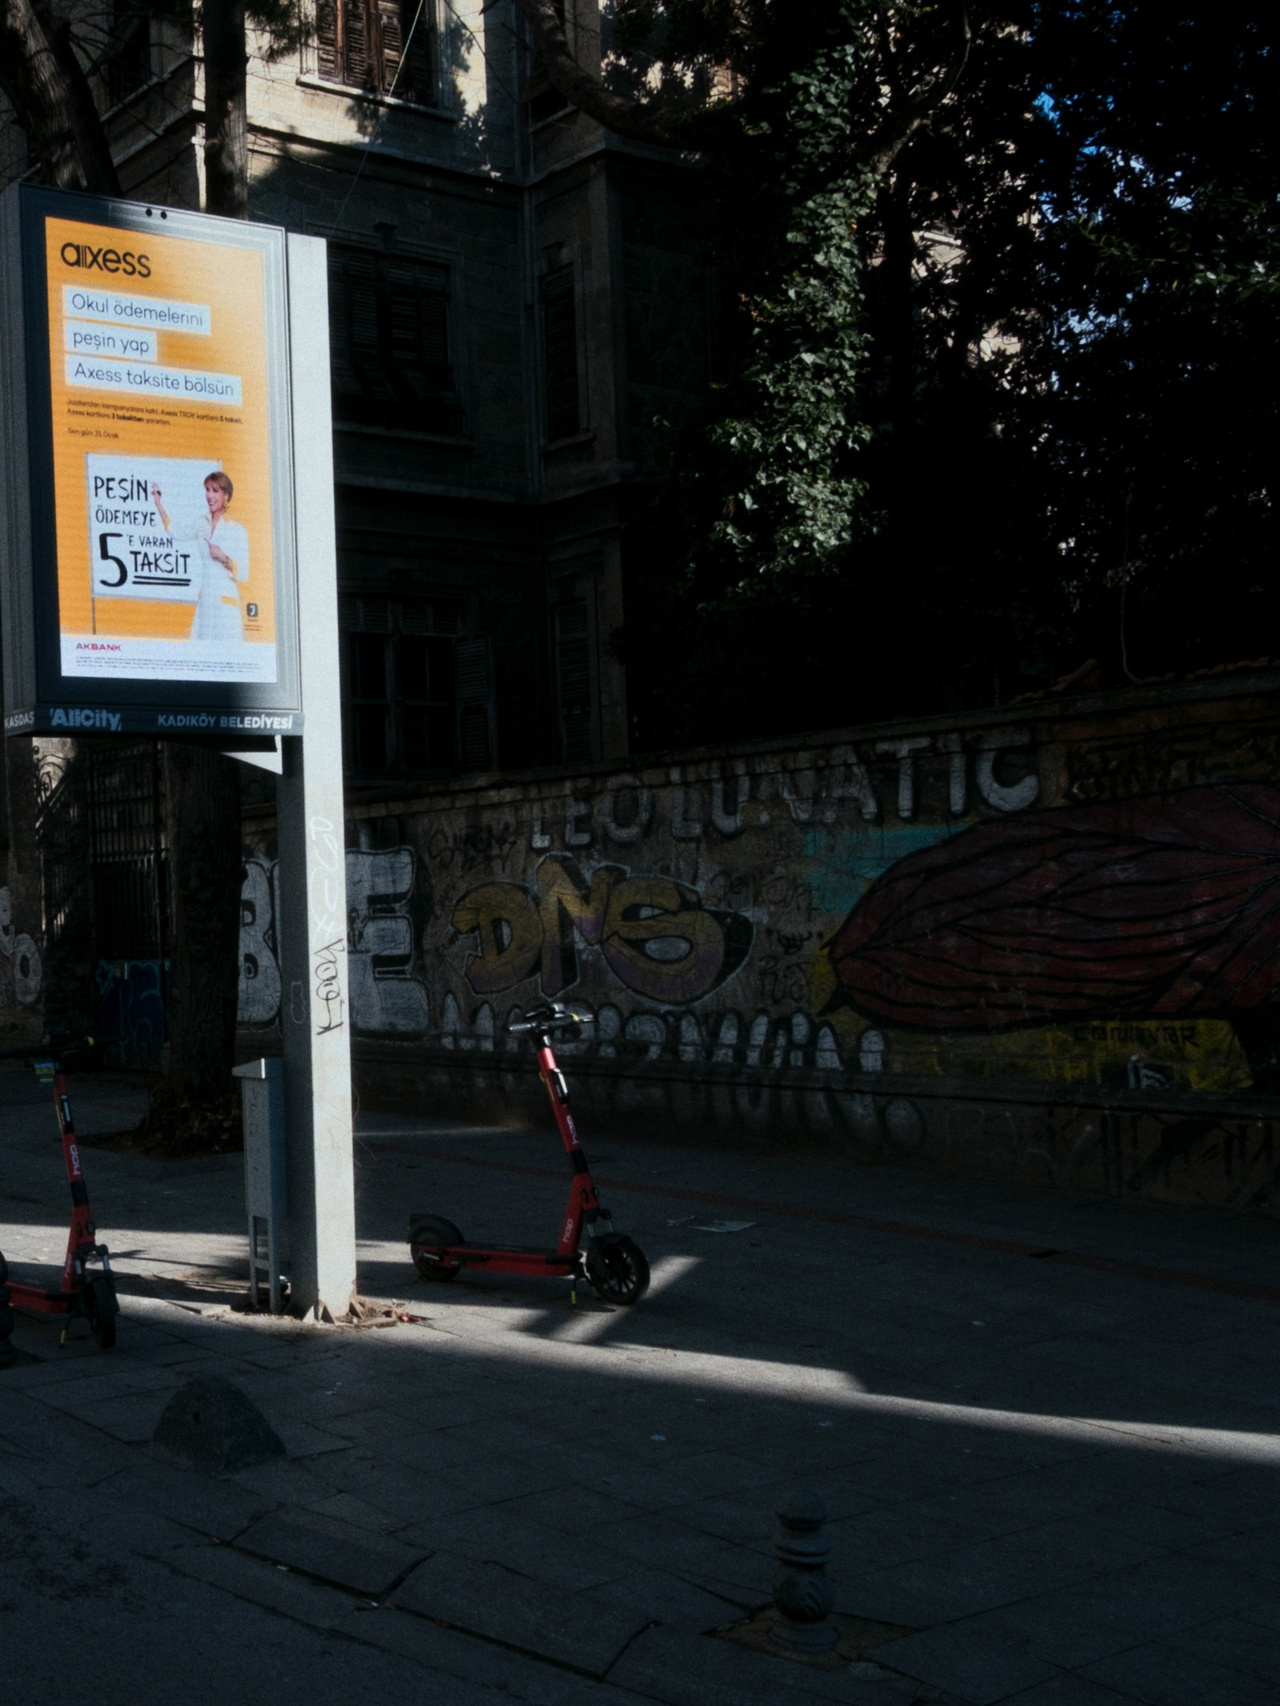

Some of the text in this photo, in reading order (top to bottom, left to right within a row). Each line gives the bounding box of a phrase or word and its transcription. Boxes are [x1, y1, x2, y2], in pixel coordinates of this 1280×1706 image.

[60, 242, 151, 278] axess
[72, 293, 203, 326] Okul ödemelerini
[73, 332, 149, 355] peşin yap
[74, 363, 234, 396] Axess taksite bölsün
[94, 474, 148, 503] PEŞİN
[95, 505, 156, 527] ÖDEMEYE
[99, 532, 128, 587] 5
[139, 536, 173, 549] VARAN
[129, 550, 190, 575] TAKSİT
[76, 642, 122, 651] AKBANK
[157, 712, 293, 730] KADIKÖY BELEDİYESİ
[70, 1144, 81, 1175] hop
